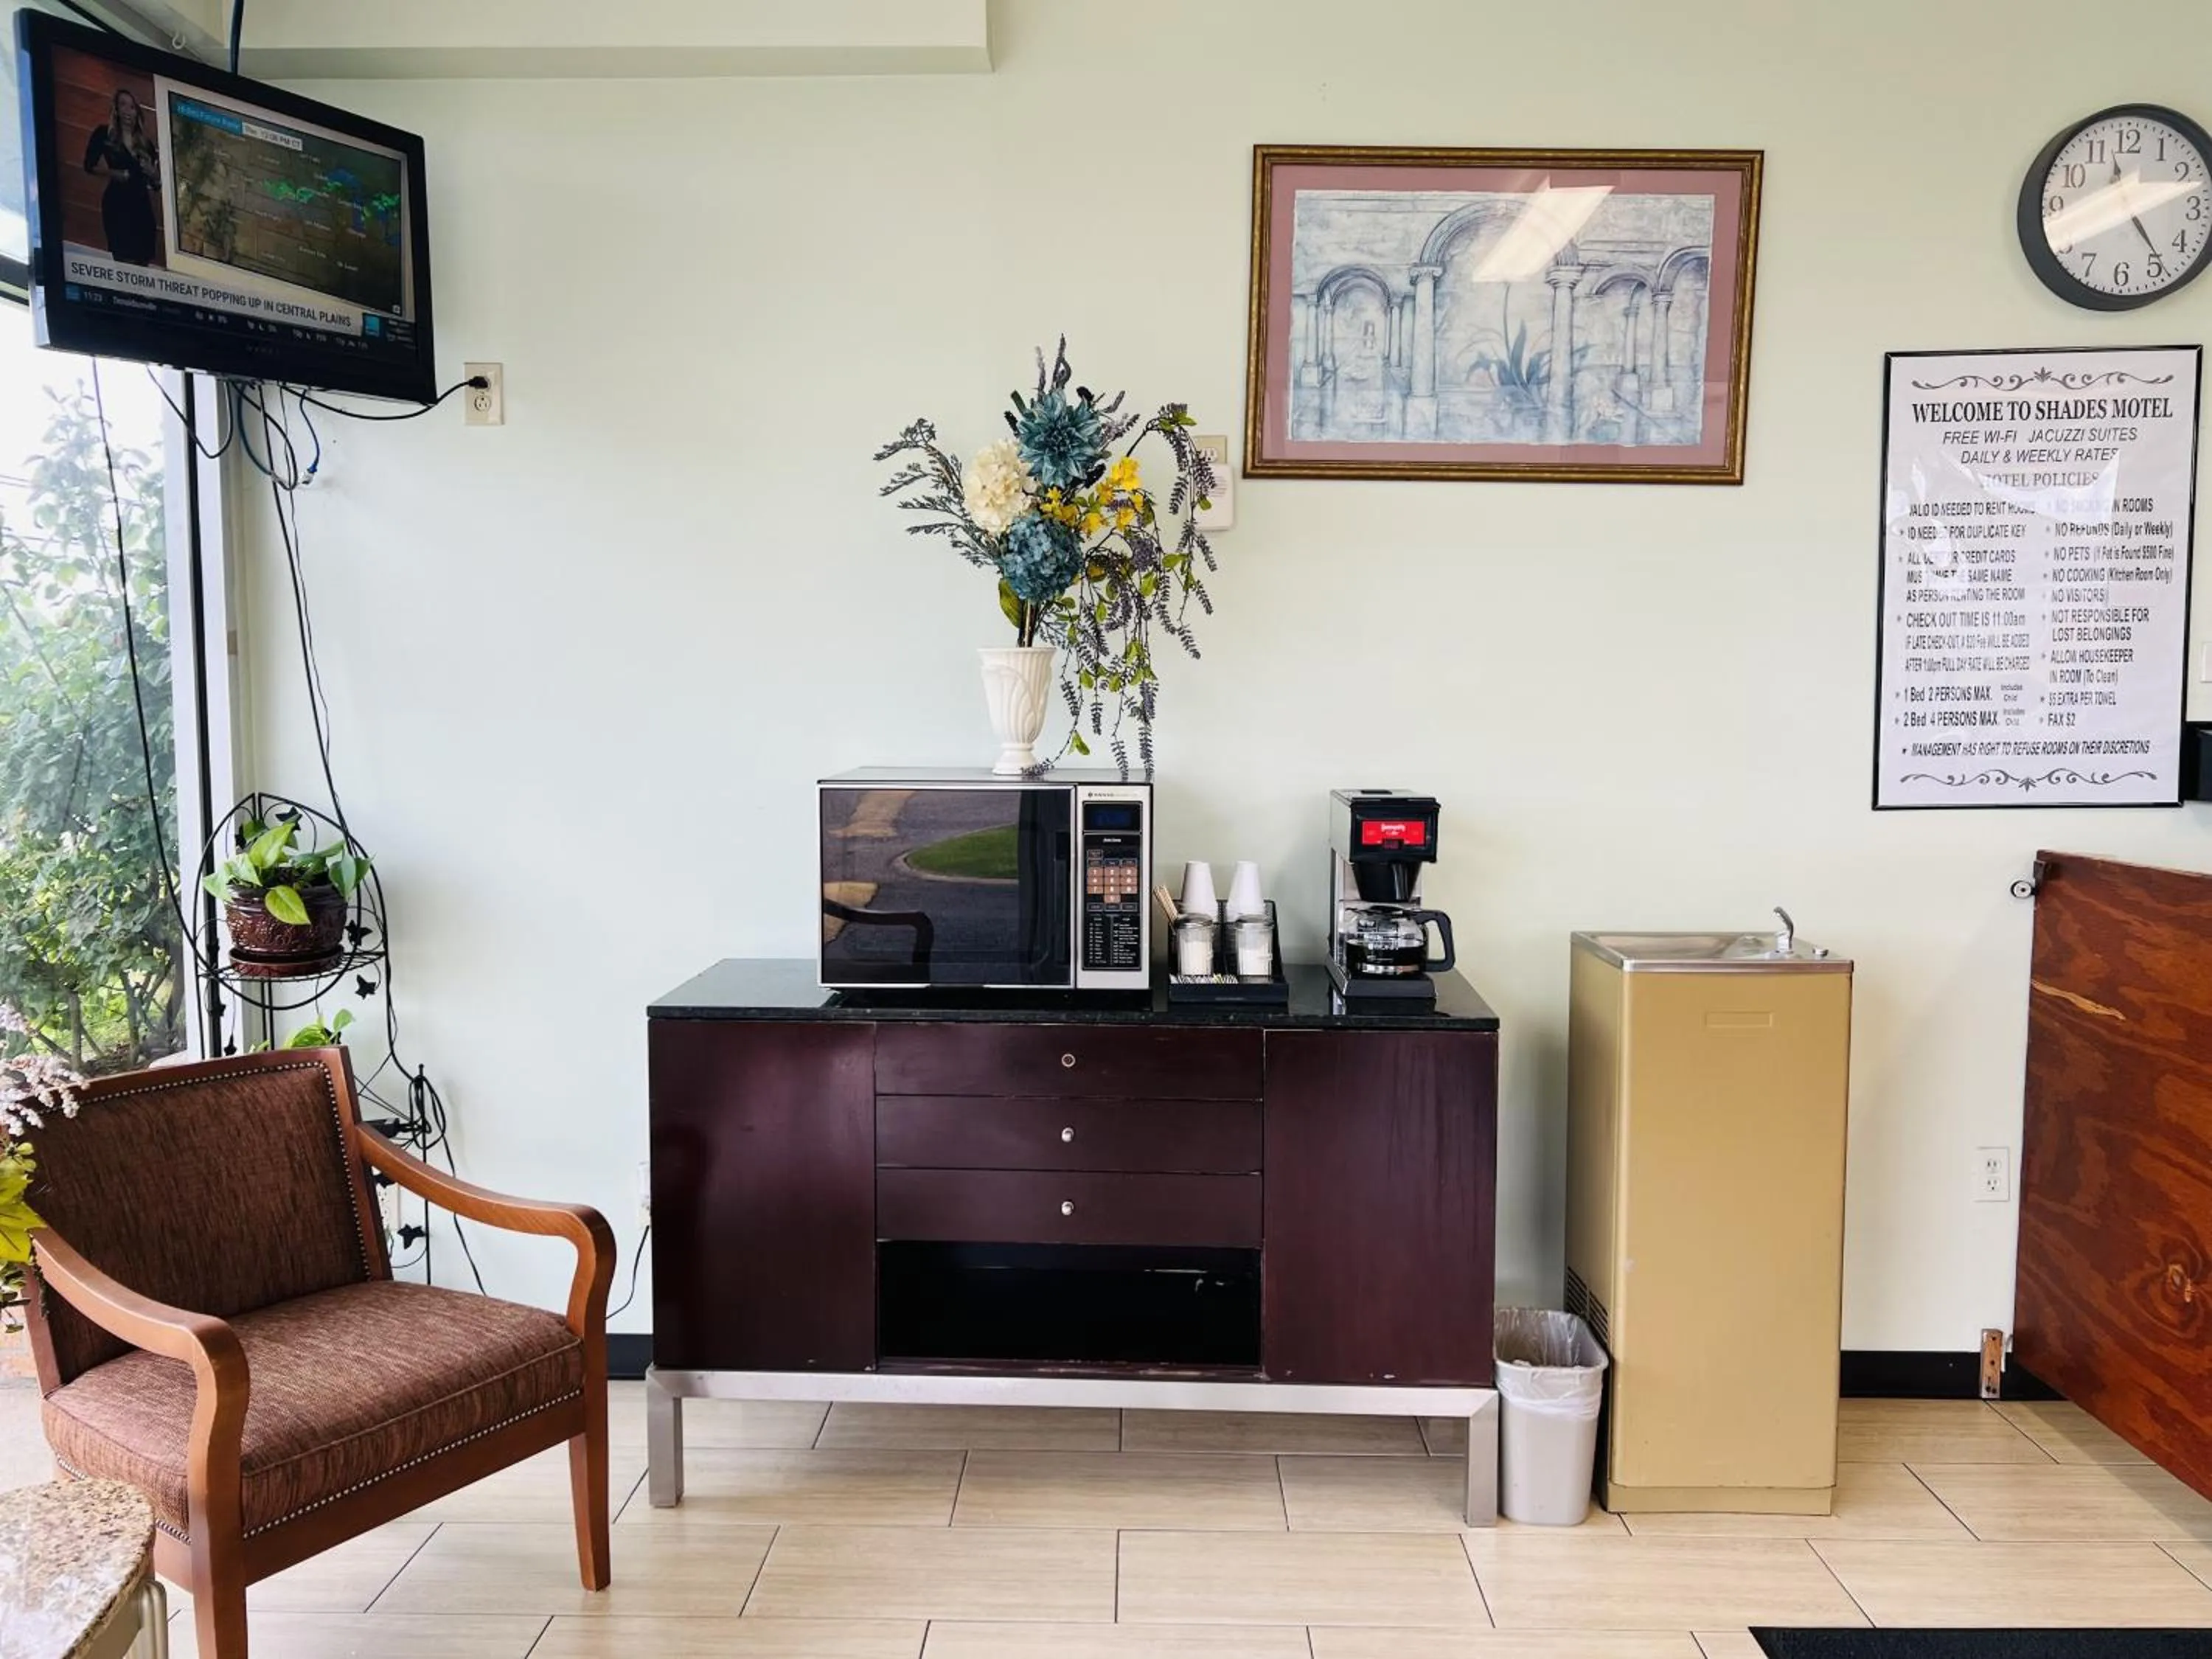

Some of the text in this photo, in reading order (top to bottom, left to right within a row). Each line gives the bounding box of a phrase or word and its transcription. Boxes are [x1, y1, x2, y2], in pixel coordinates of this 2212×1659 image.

[2113, 129, 2142, 154] 12
[2155, 137, 2166, 162] 1
[2085, 139, 2107, 164] 11
[2062, 163, 2086, 189] 10
[2174, 161, 2193, 184] 2
[2185, 195, 2202, 221] 3
[2171, 229, 2188, 253] 4
[2081, 252, 2097, 278] 7
[2146, 253, 2163, 279] 5
[2113, 262, 2130, 287] 6
[71, 262, 352, 327] SEVERE STORM THREAT POPPING UP IN CENTRAL PLAINS
[1912, 397, 2173, 423] WELCOME TO SHADES MOTEL
[1943, 427, 2138, 444] FREE WI-FI JACUZZI SUITES
[1961, 448, 2120, 464] DAILY & WEEKLY RATES
[1984, 473, 2030, 487] OTEL
[1932, 503, 1939, 517] ID
[1941, 502, 1972, 516] NEEDED
[1974, 502, 1984, 515] TO
[1986, 501, 2006, 515] RENT
[2123, 498, 2154, 512] ROOMS
[1907, 526, 1916, 540] ID
[1949, 526, 1965, 539] FOR
[1966, 524, 2009, 539] DUPLICATE
[2011, 524, 2027, 538] KEY
[2055, 520, 2174, 539] NO REFUNDS (Daily or Weekly)
[1989, 549, 2016, 564] CARDS
[2053, 546, 2066, 561] NO
[2068, 546, 2090, 561] PETS
[2121, 545, 2140, 560] Found
[1968, 568, 1989, 582] SAME
[1990, 568, 2012, 582] NAME
[2052, 568, 2065, 582] NO
[2067, 568, 2105, 582] COOKING
[2135, 566, 2153, 581] Room
[1907, 589, 1917, 602] AS
[1985, 588, 2000, 602] THE
[2002, 587, 2025, 601] ROOM
[2051, 588, 2105, 602] NO VISITORS
[1907, 613, 1937, 627] CHECK
[1938, 612, 1957, 627] OUT
[1960, 611, 1980, 627] TIME
[1981, 611, 1991, 627] IS
[2051, 608, 2149, 623] NOT RESPONSIBLE FOR
[2052, 627, 2132, 641] LOST BELONGINGS
[2051, 648, 2135, 664] ALLOW HOUSEKEEPER
[2050, 669, 2118, 686] IN ROOM (To Clean)
[1910, 686, 1925, 701] Bed
[1928, 686, 1933, 701] 2
[1935, 686, 1972, 701] PERSONS
[1974, 685, 1993, 701] MAX.
[2058, 692, 2079, 706] EXTRA
[2080, 692, 2093, 706] PER
[2094, 692, 2117, 706] TOWEL
[1903, 712, 1909, 727] 2
[1910, 712, 1927, 727] Bed
[1930, 712, 1935, 726] 4
[1937, 711, 1978, 726] PERSONS
[2048, 712, 2076, 727] FAX $2
[1911, 740, 2151, 757] MANAGEMENT HAS RIGHT TO REFUSE ROOMS ON THEIR DISCRETIONS
